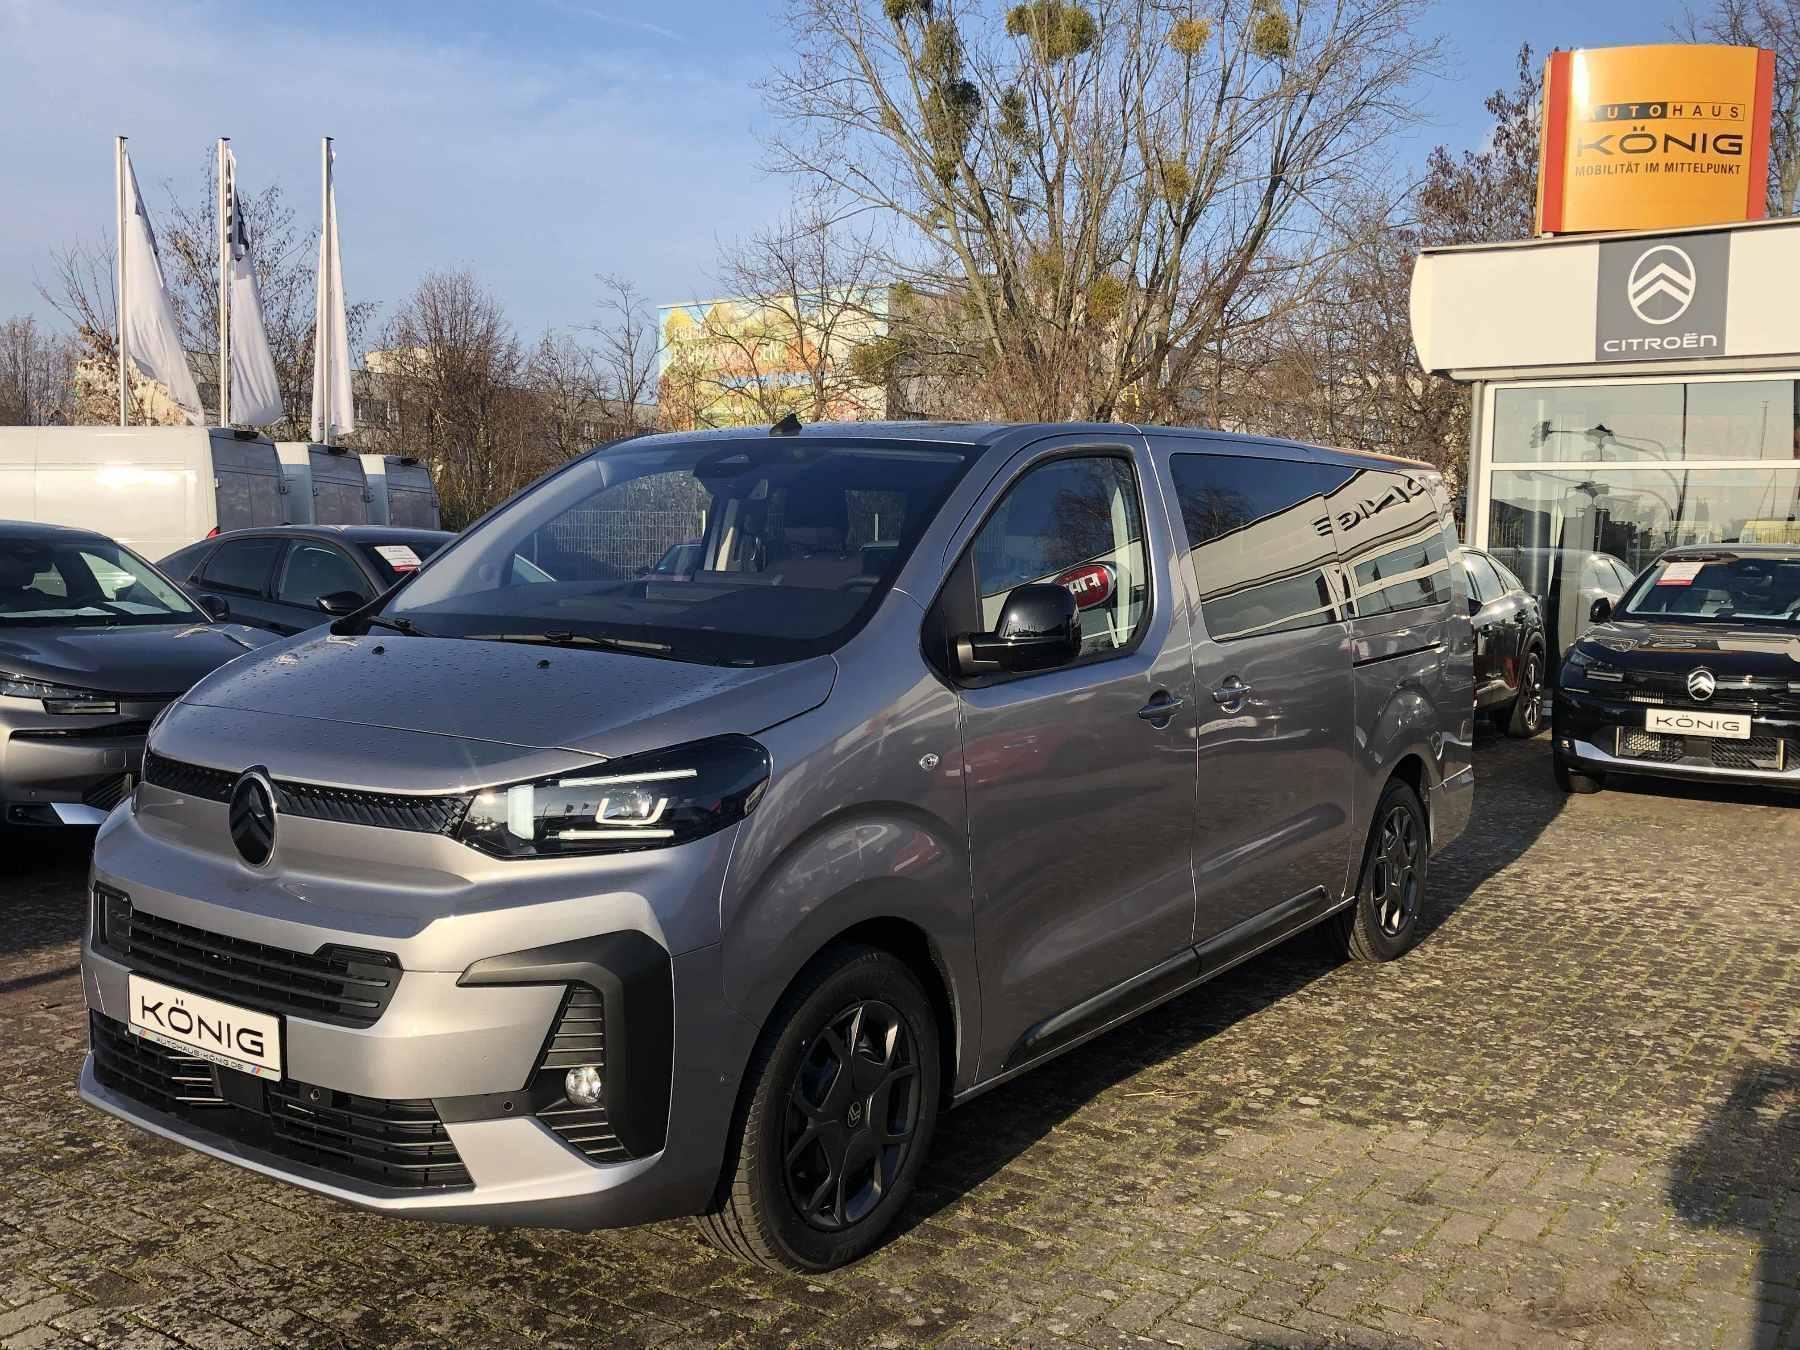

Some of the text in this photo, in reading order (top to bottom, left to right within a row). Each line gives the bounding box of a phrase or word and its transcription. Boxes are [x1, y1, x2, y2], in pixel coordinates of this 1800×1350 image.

[1576, 125, 1743, 157] KÖNIG
[1575, 162, 1741, 177] MOBILITÄT IM MITTELPUNKT
[1655, 714, 1740, 732] KÖNIG
[141, 995, 265, 1058] KÖNIG
